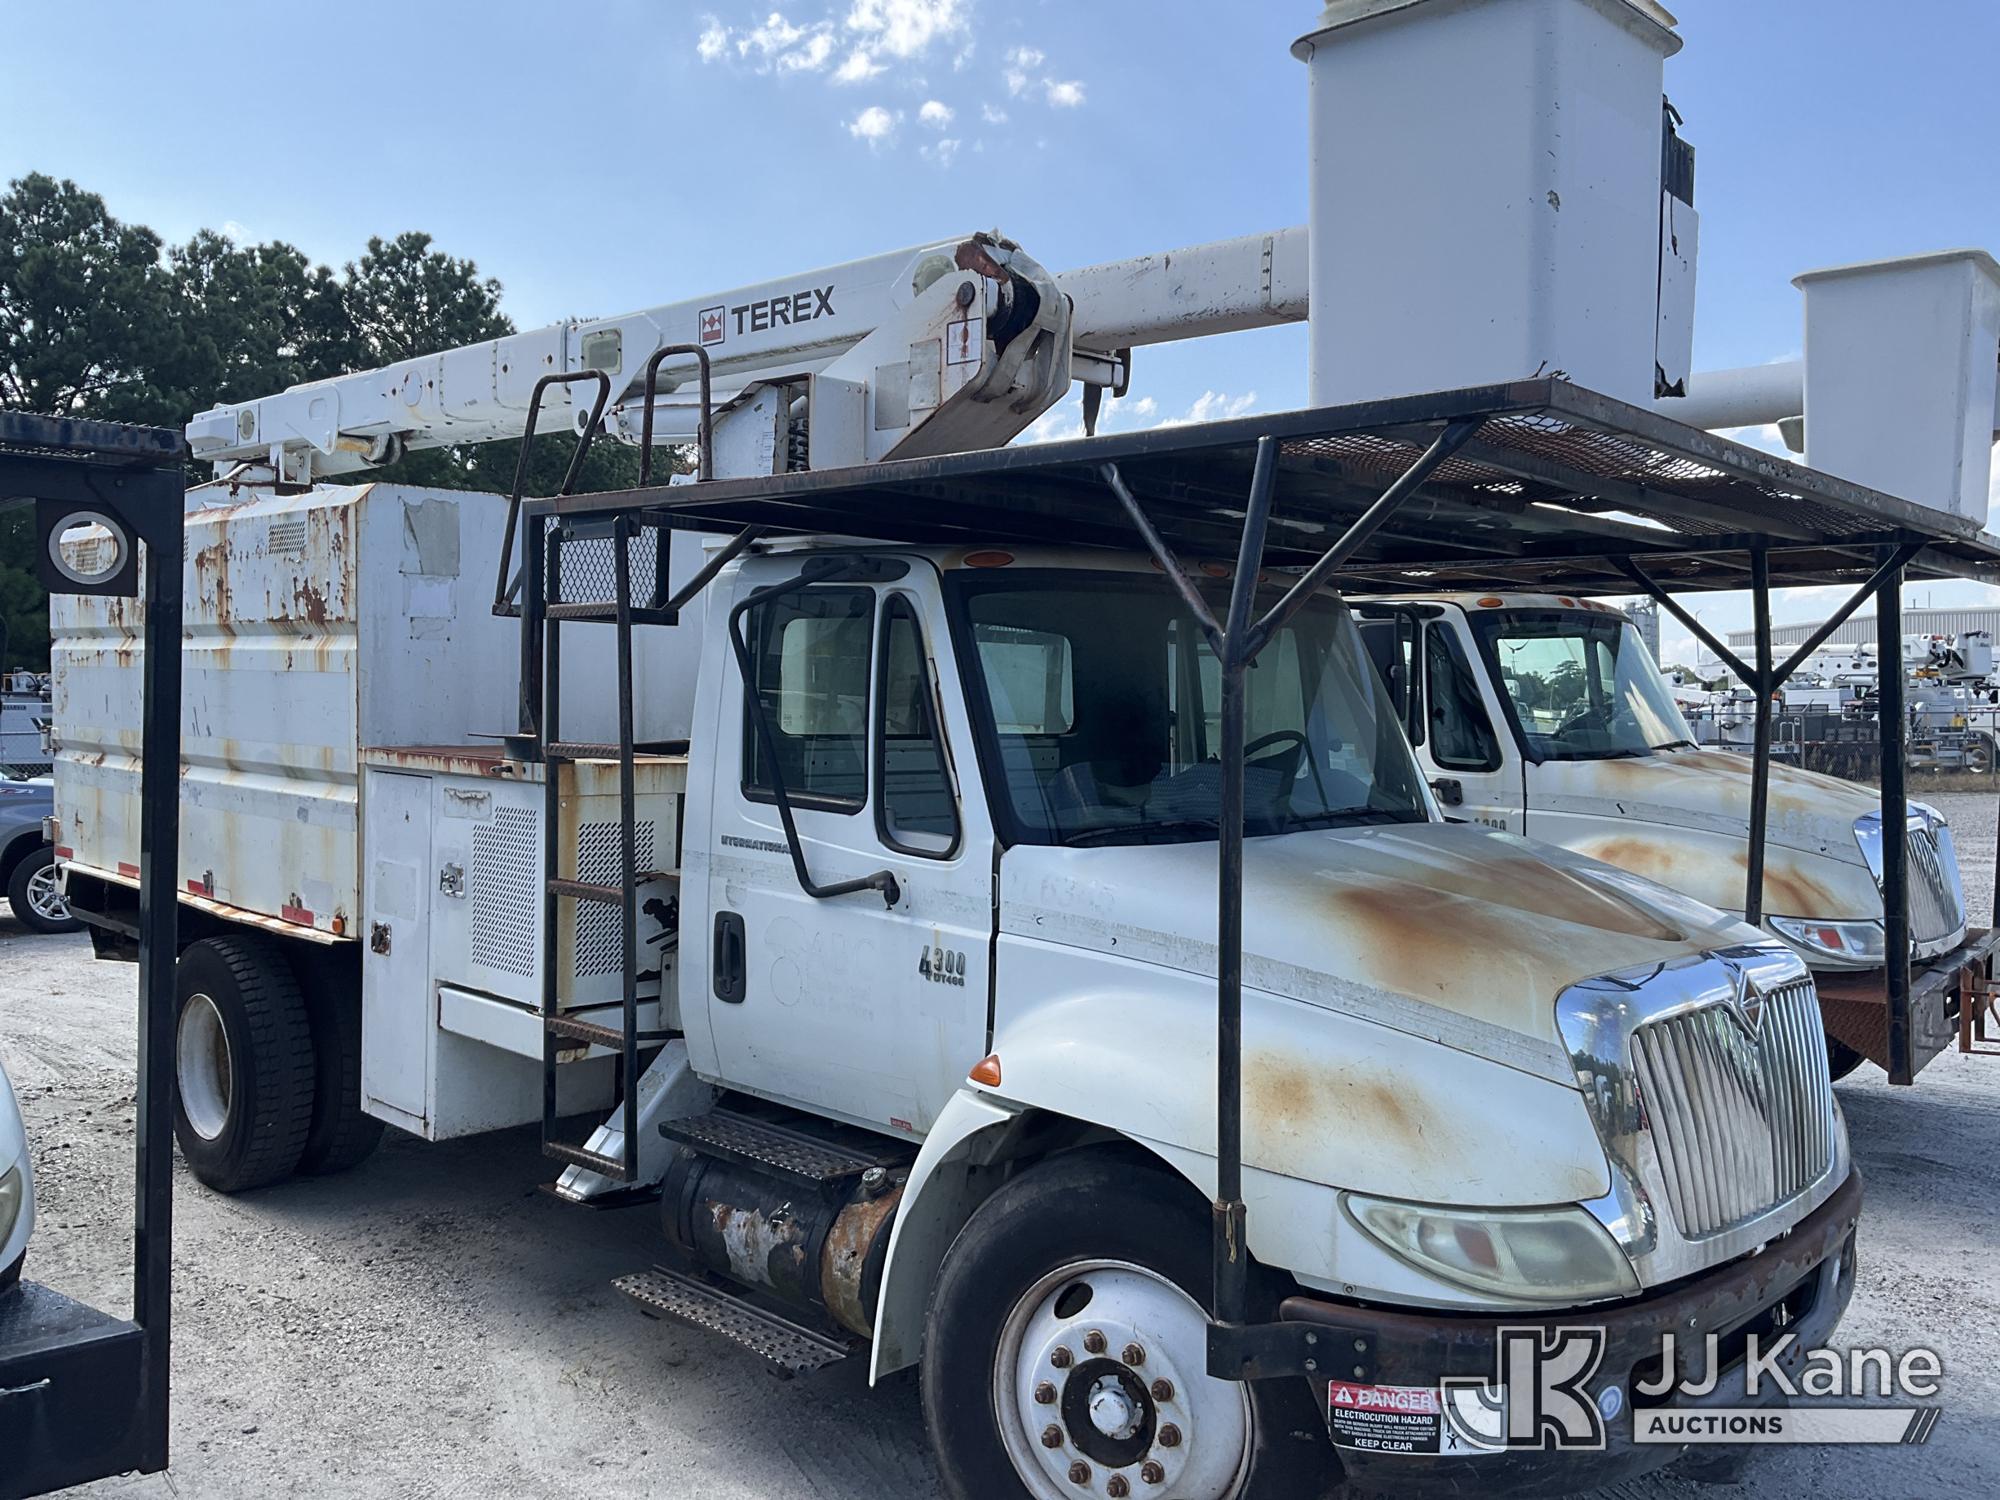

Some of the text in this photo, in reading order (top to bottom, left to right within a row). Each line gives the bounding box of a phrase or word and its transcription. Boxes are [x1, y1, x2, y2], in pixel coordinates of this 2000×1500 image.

[731, 285, 835, 336] TEREX
[918, 945, 966, 981] 4300
[1356, 1389, 1433, 1411] DANGER
[1335, 1408, 1433, 1425] ELECTROCUTION HAZARD
[1354, 1437, 1413, 1451] KEEP CLEAR
